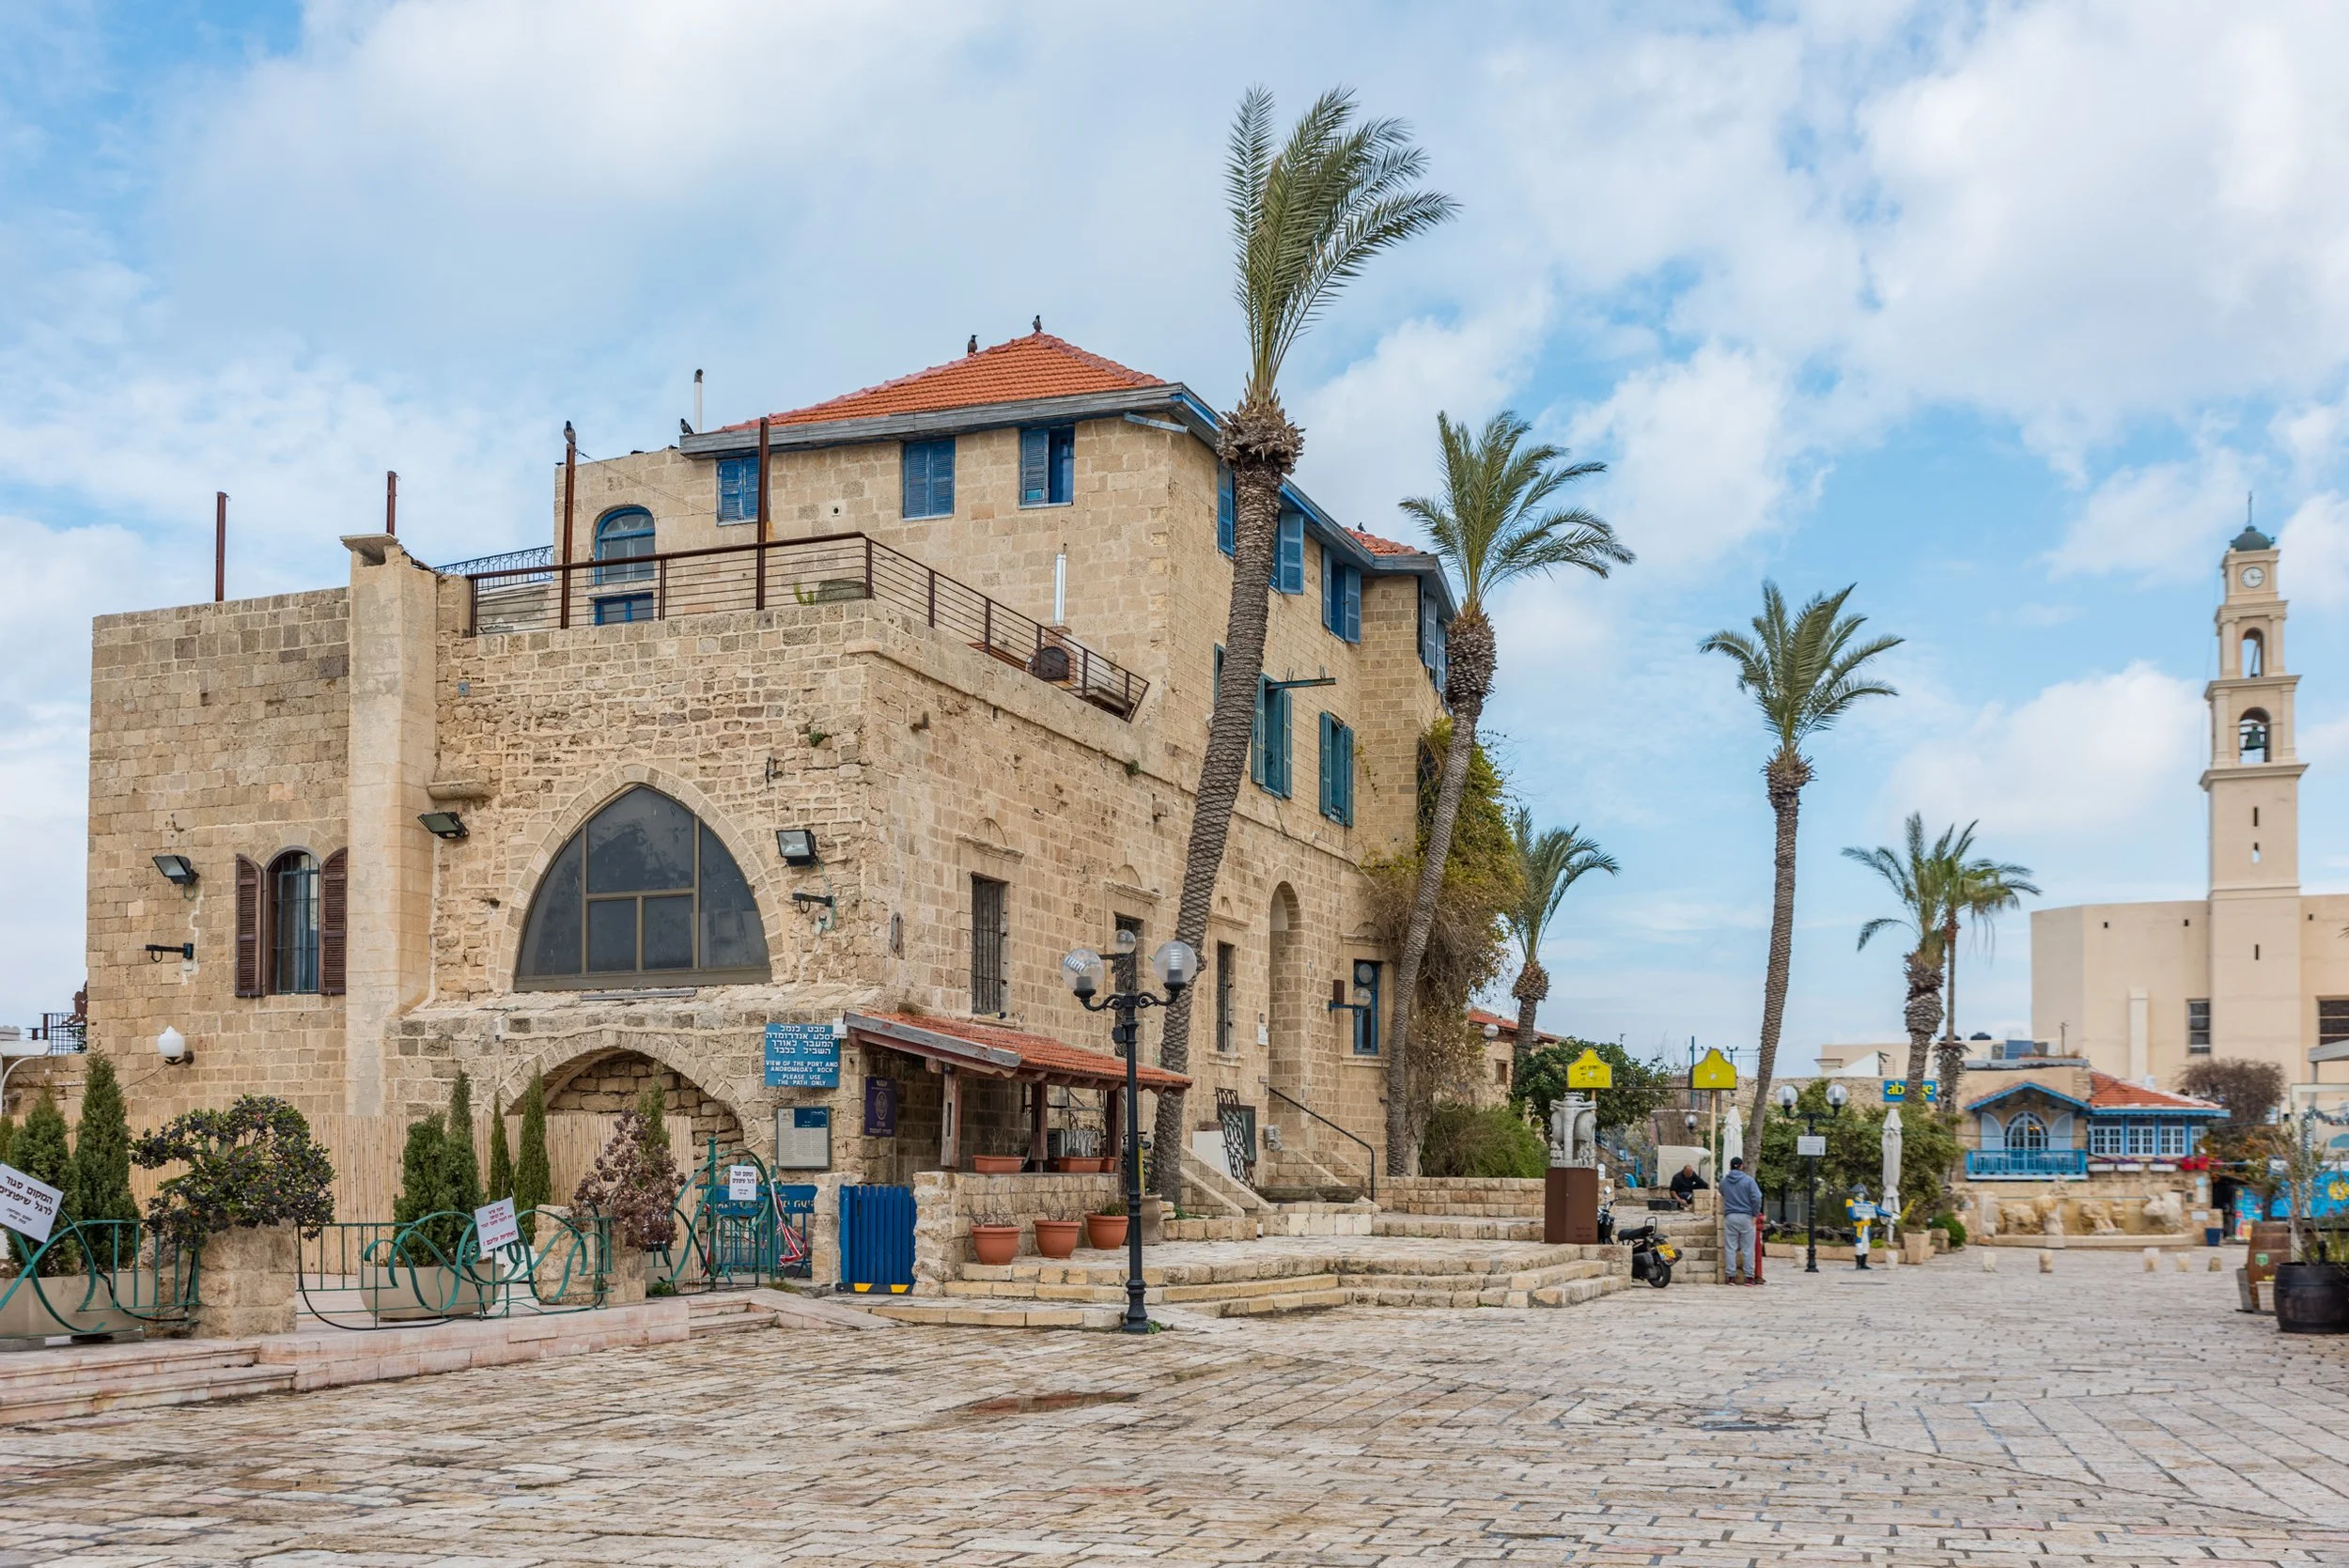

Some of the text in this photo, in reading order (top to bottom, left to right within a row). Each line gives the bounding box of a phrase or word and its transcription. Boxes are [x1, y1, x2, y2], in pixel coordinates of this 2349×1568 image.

[813, 1032, 839, 1041] לסלע
[0, 1185, 31, 1205] שיפוצים
[6, 1175, 54, 1204] המקום סגור
[35, 1201, 53, 1216] לרגל
